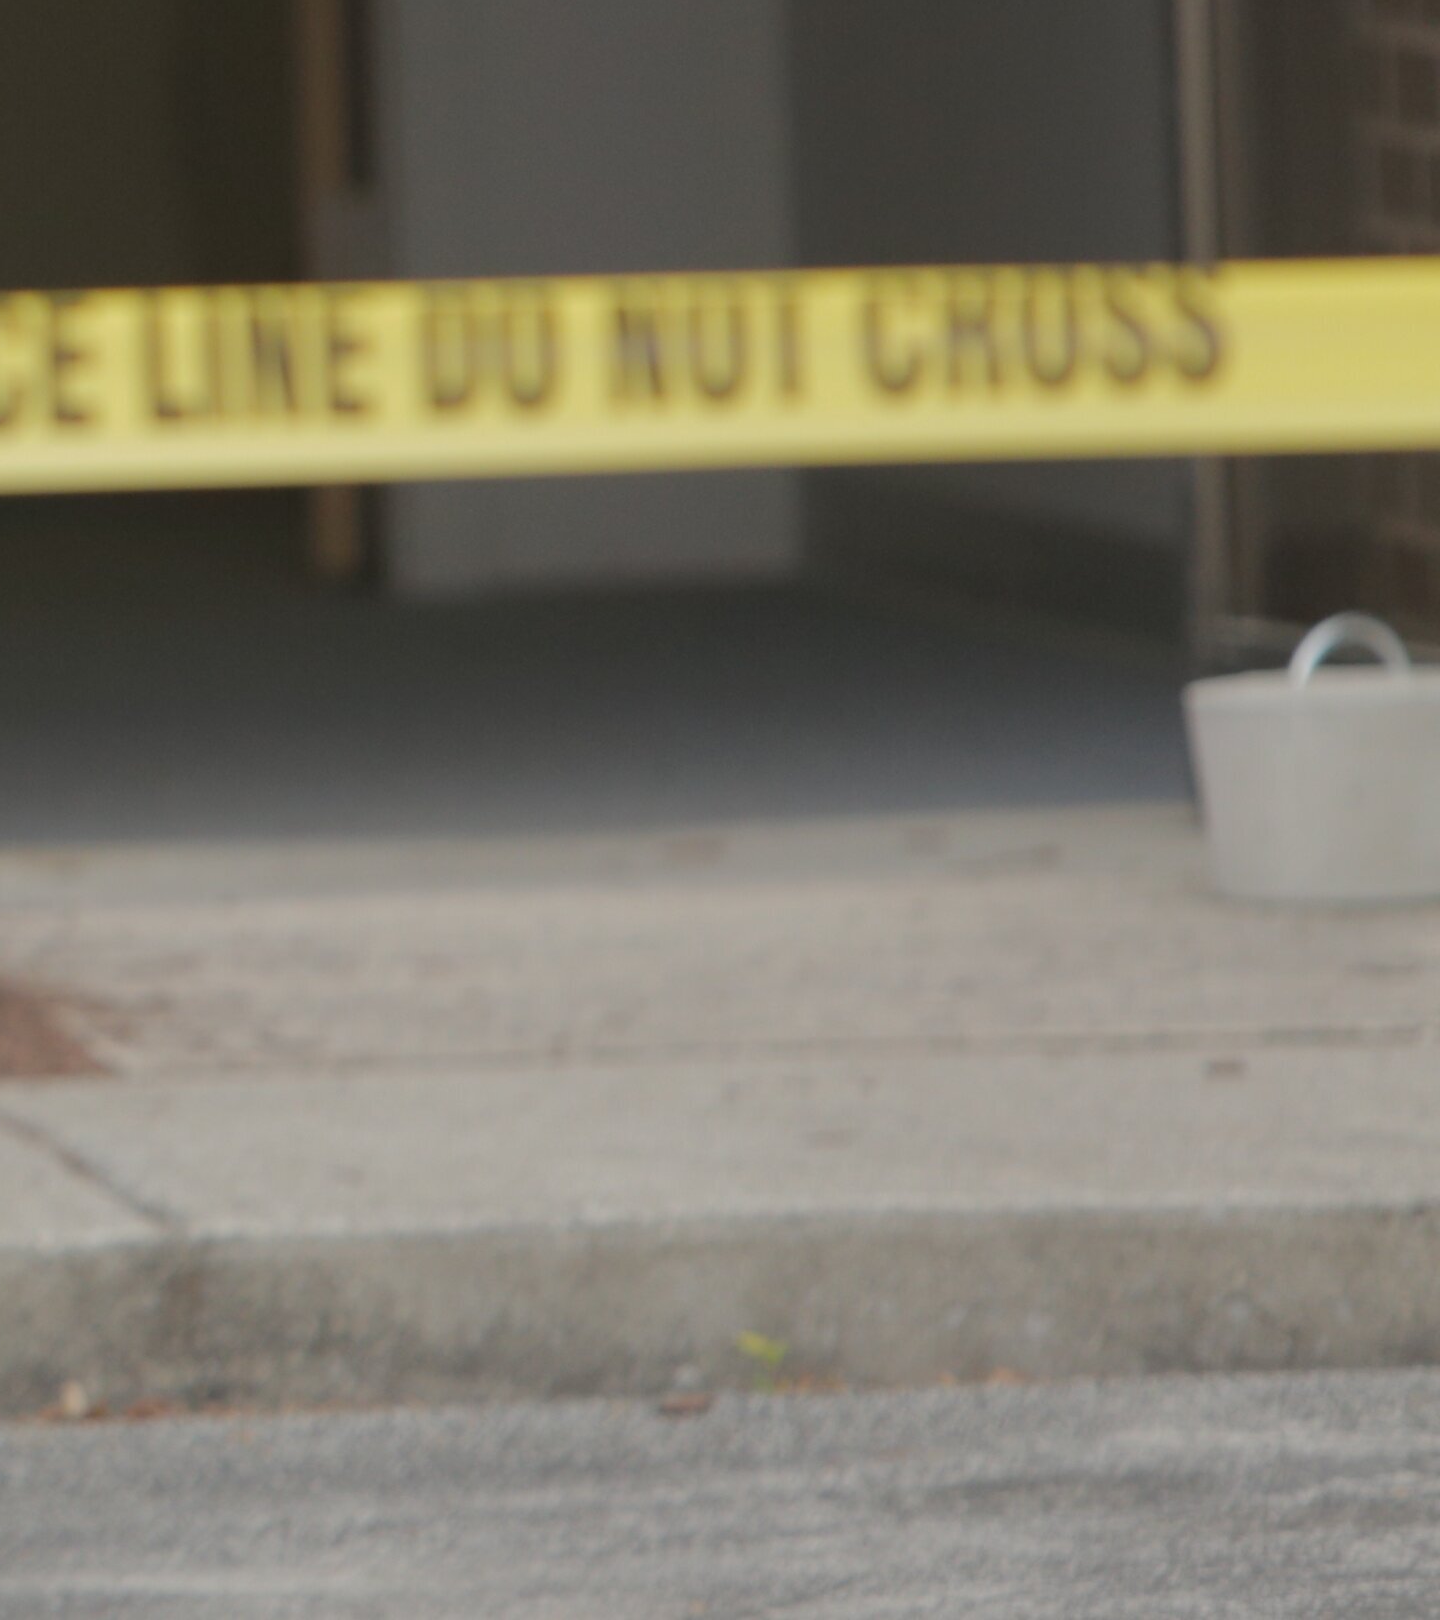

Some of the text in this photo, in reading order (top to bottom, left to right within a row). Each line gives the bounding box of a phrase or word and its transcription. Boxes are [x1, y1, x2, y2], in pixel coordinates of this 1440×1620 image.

[142, 286, 370, 420] LINE
[419, 283, 553, 408] DO
[607, 273, 803, 400] NOT
[865, 266, 1221, 392] CROSS
